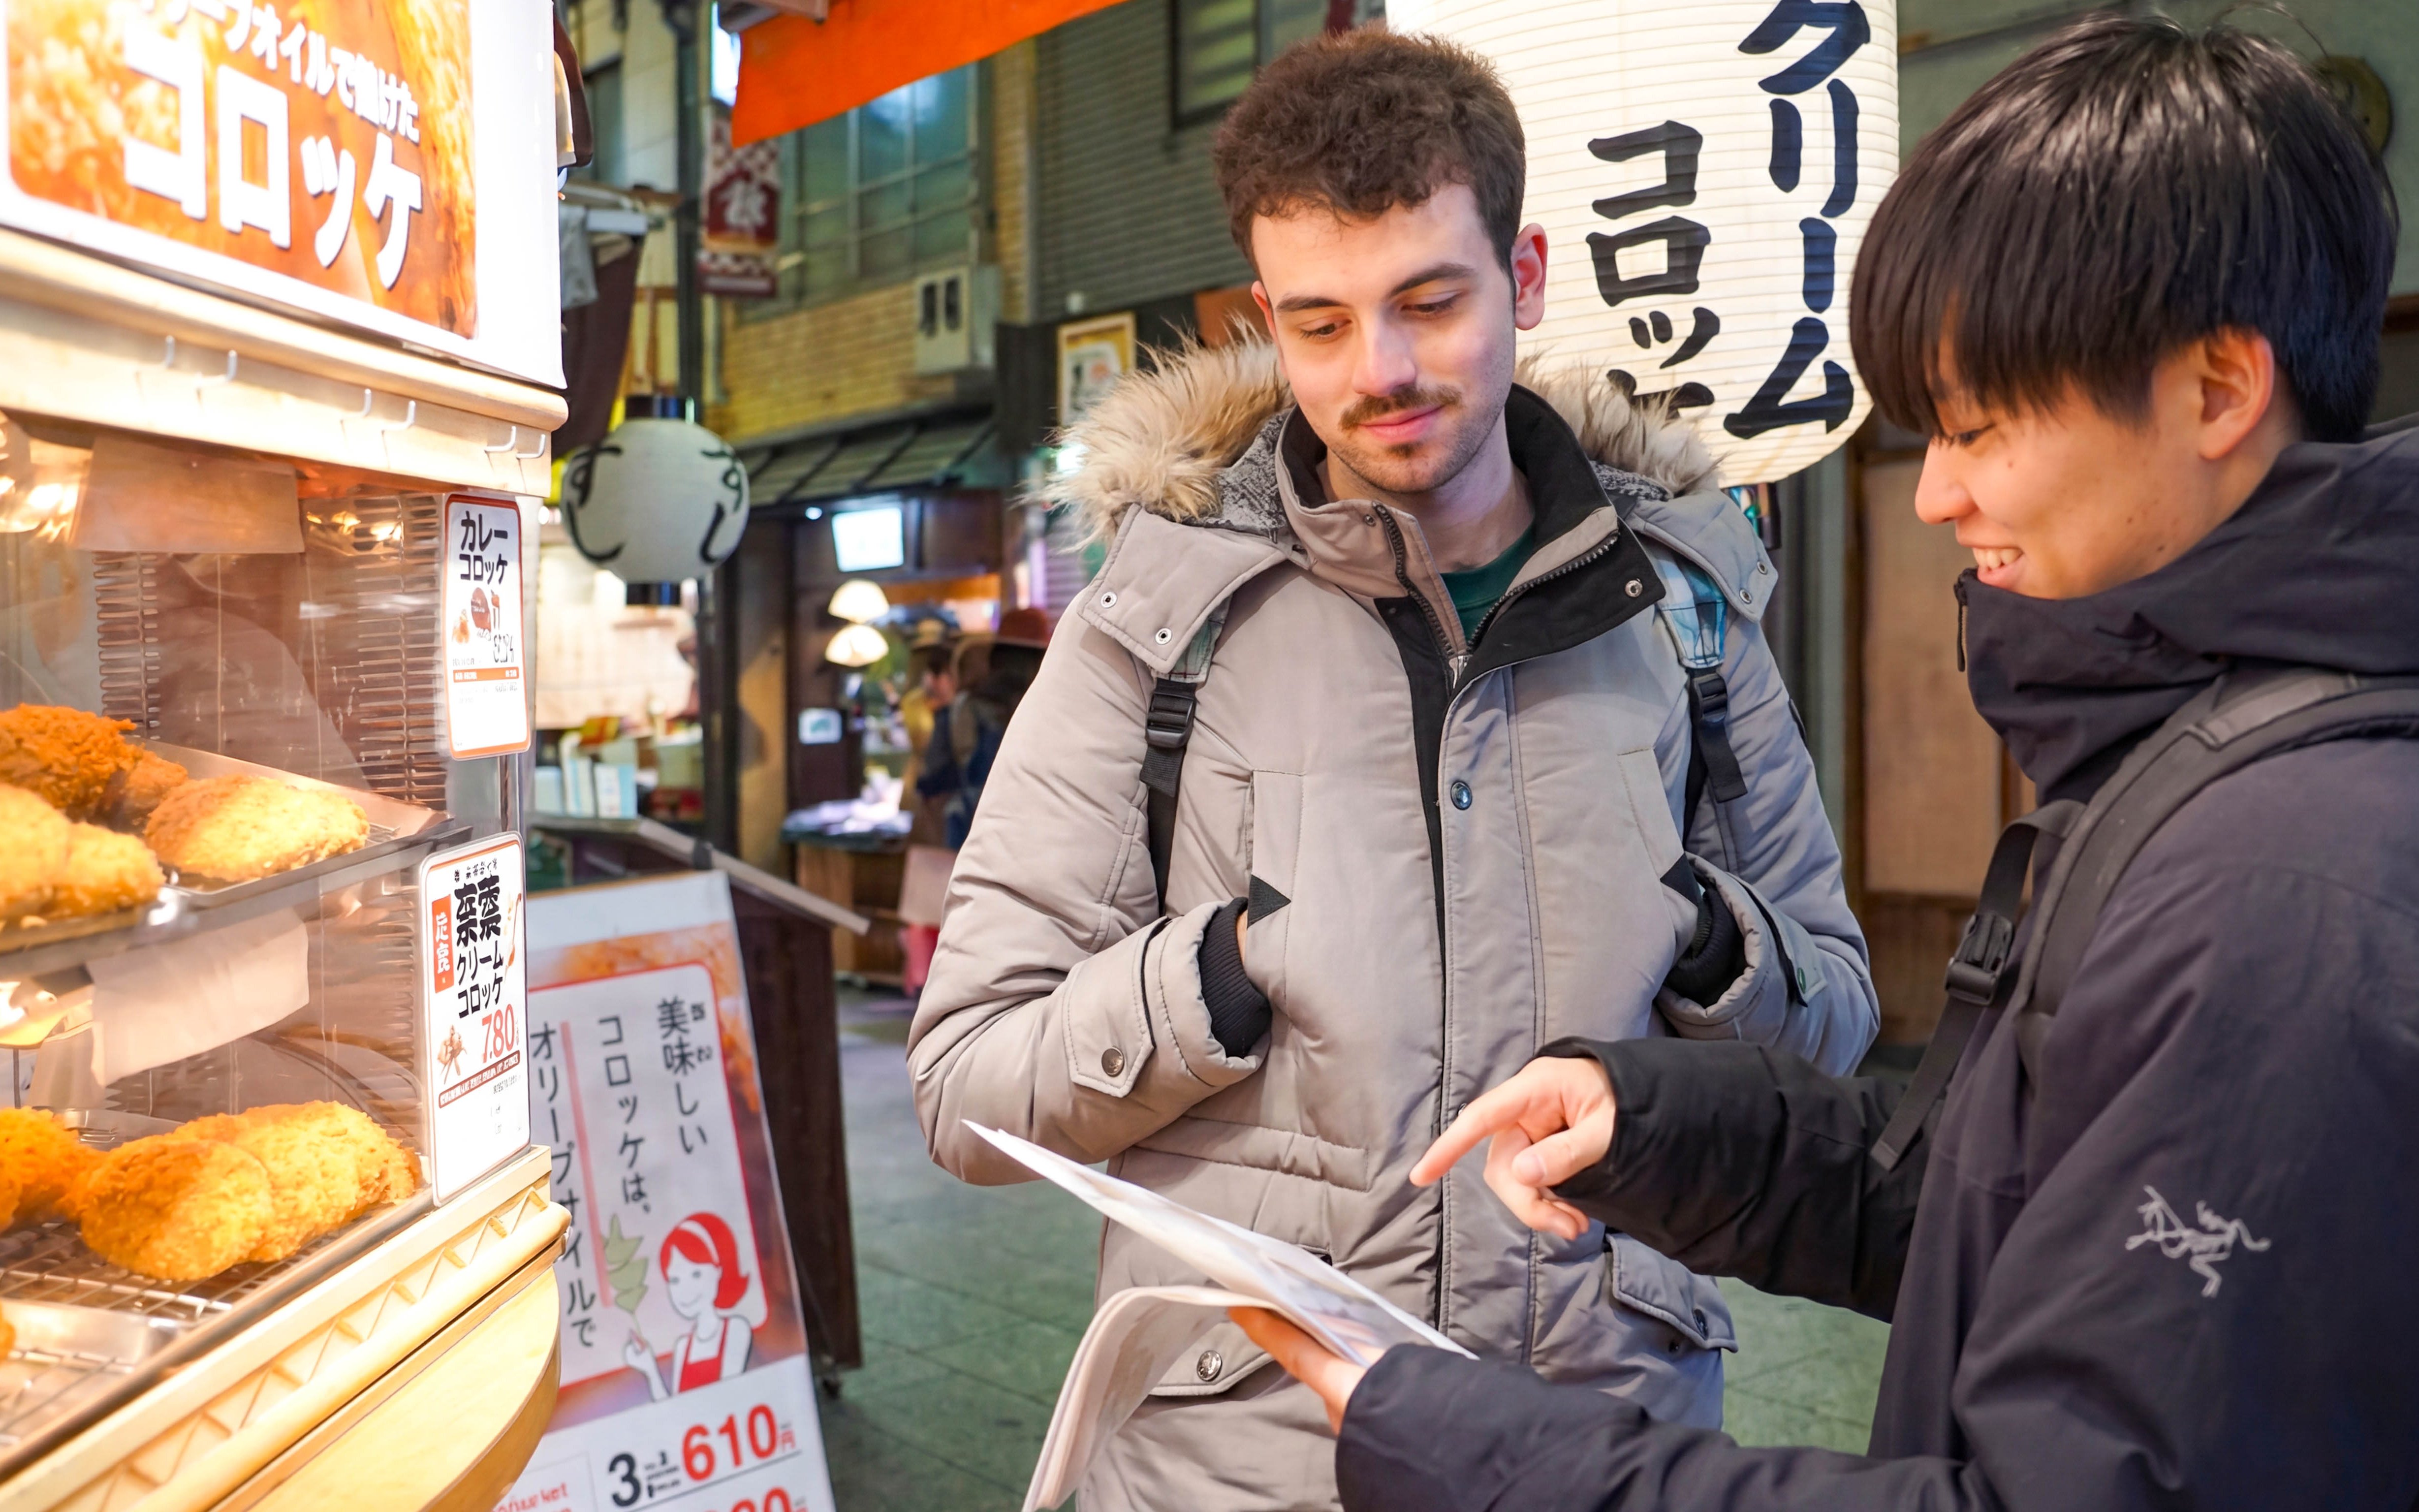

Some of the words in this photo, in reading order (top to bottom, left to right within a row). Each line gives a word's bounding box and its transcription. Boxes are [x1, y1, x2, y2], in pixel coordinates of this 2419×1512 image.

[122, 22, 422, 290] コロッケ
[1723, 0, 1870, 440] クリーム
[461, 510, 508, 552] カレー
[459, 553, 508, 585] コロッケ
[457, 940, 503, 986] クリーム
[458, 973, 503, 1019] コロッケ
[658, 995, 708, 1155] 美味しい
[609, 1452, 641, 1507] 3
